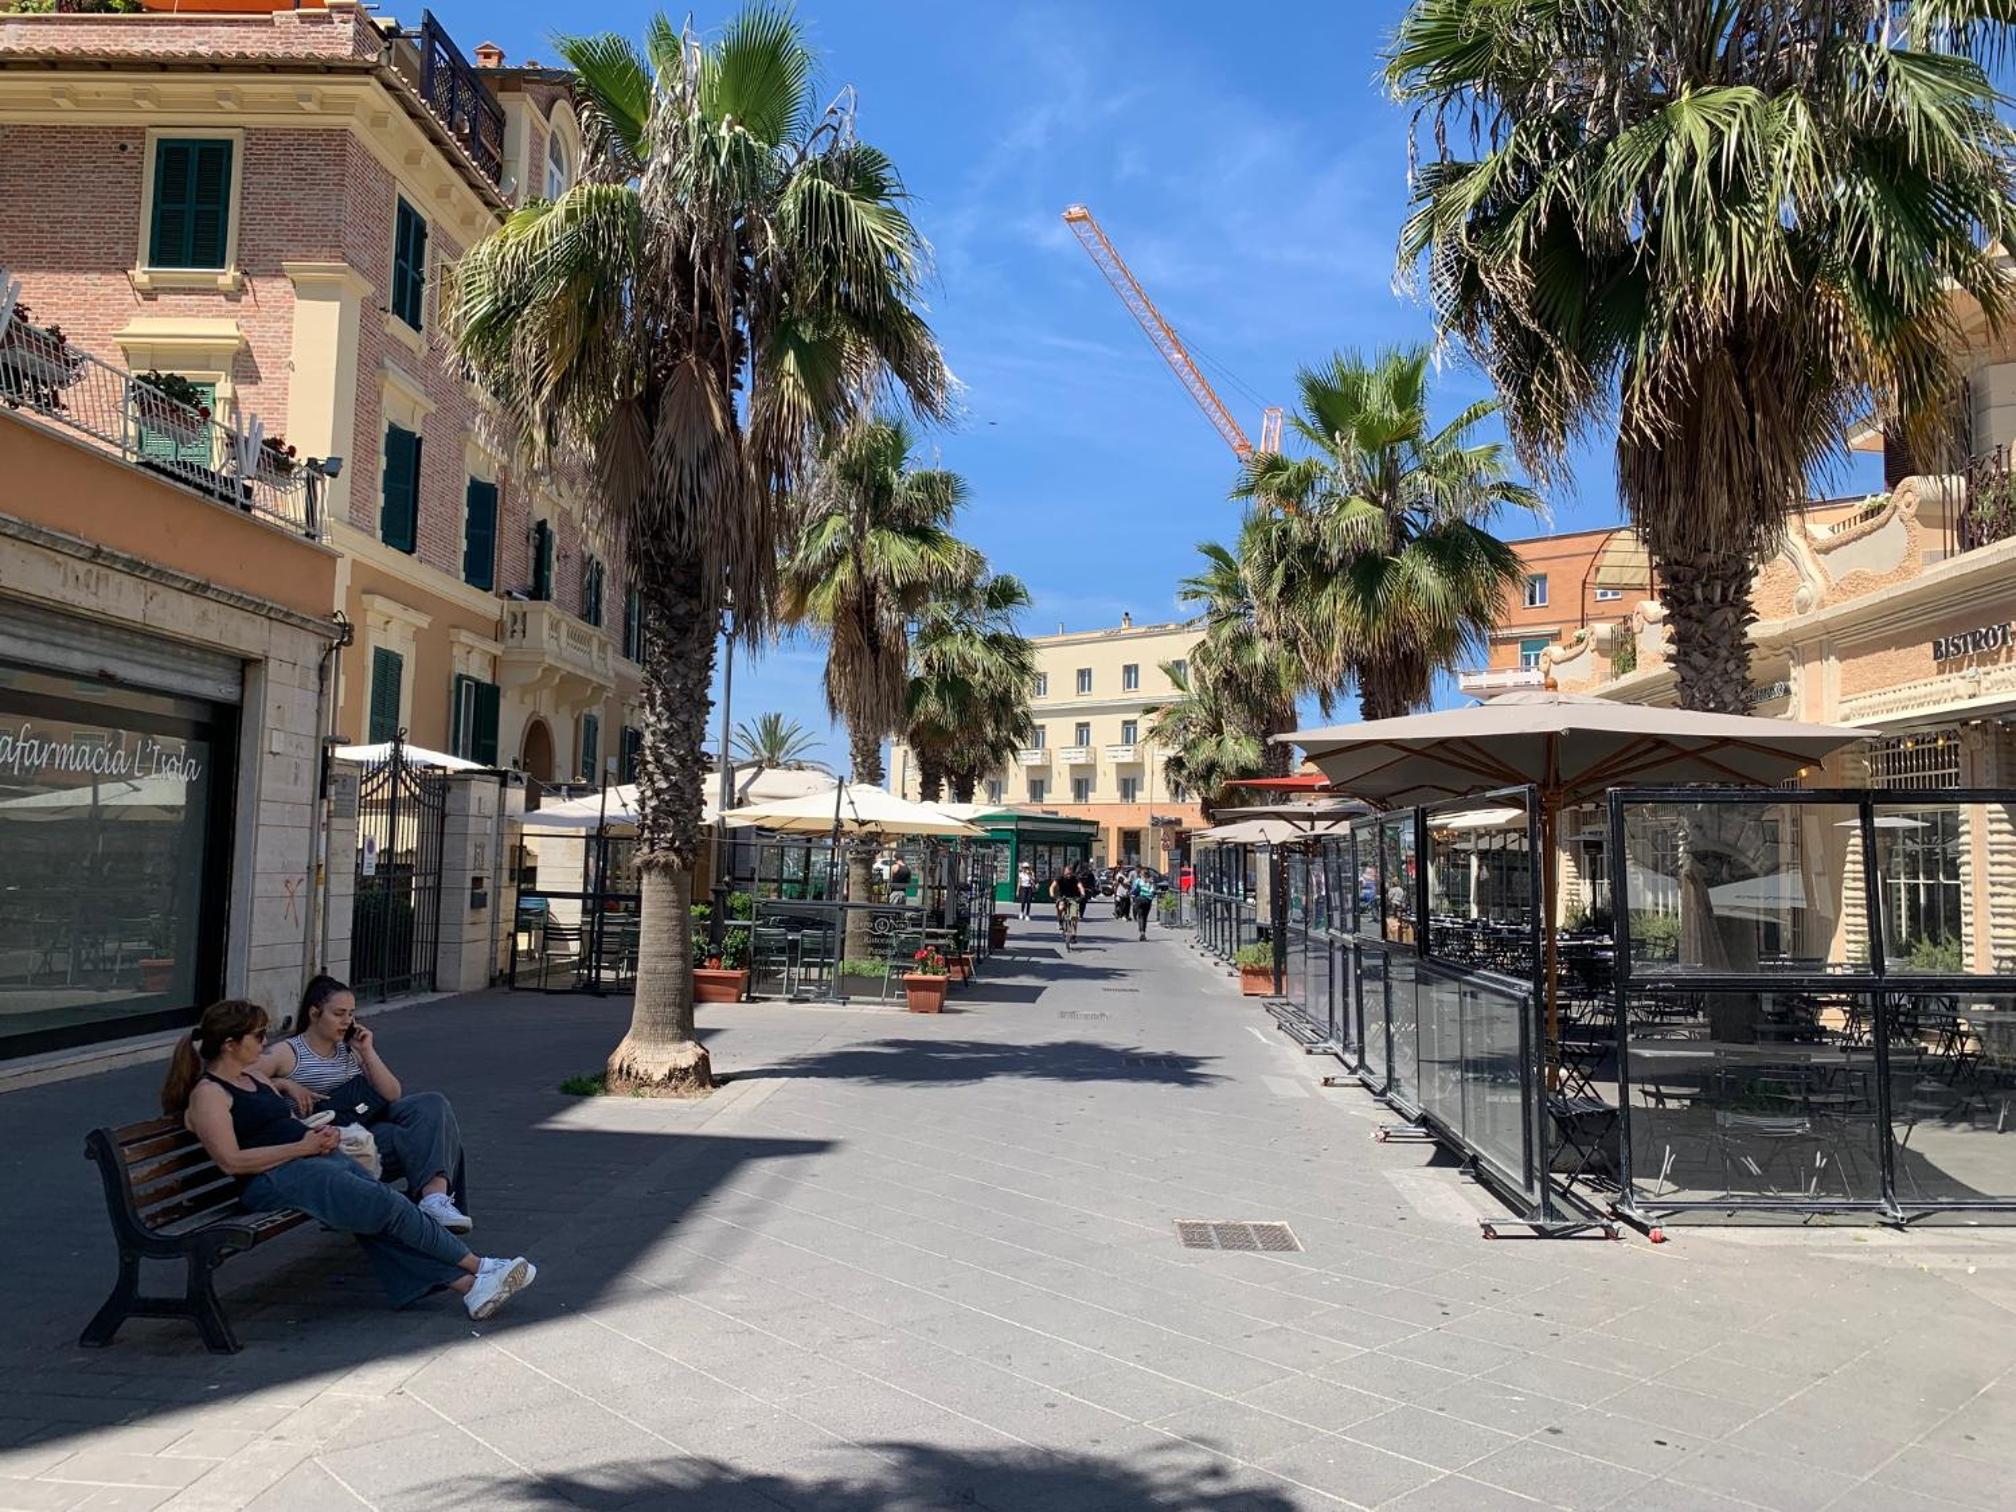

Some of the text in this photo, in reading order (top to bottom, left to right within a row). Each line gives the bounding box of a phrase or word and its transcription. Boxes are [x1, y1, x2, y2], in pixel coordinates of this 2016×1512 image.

[1932, 622, 2013, 662] BISTROT
[0, 723, 202, 783] afarmacia L'Isola
